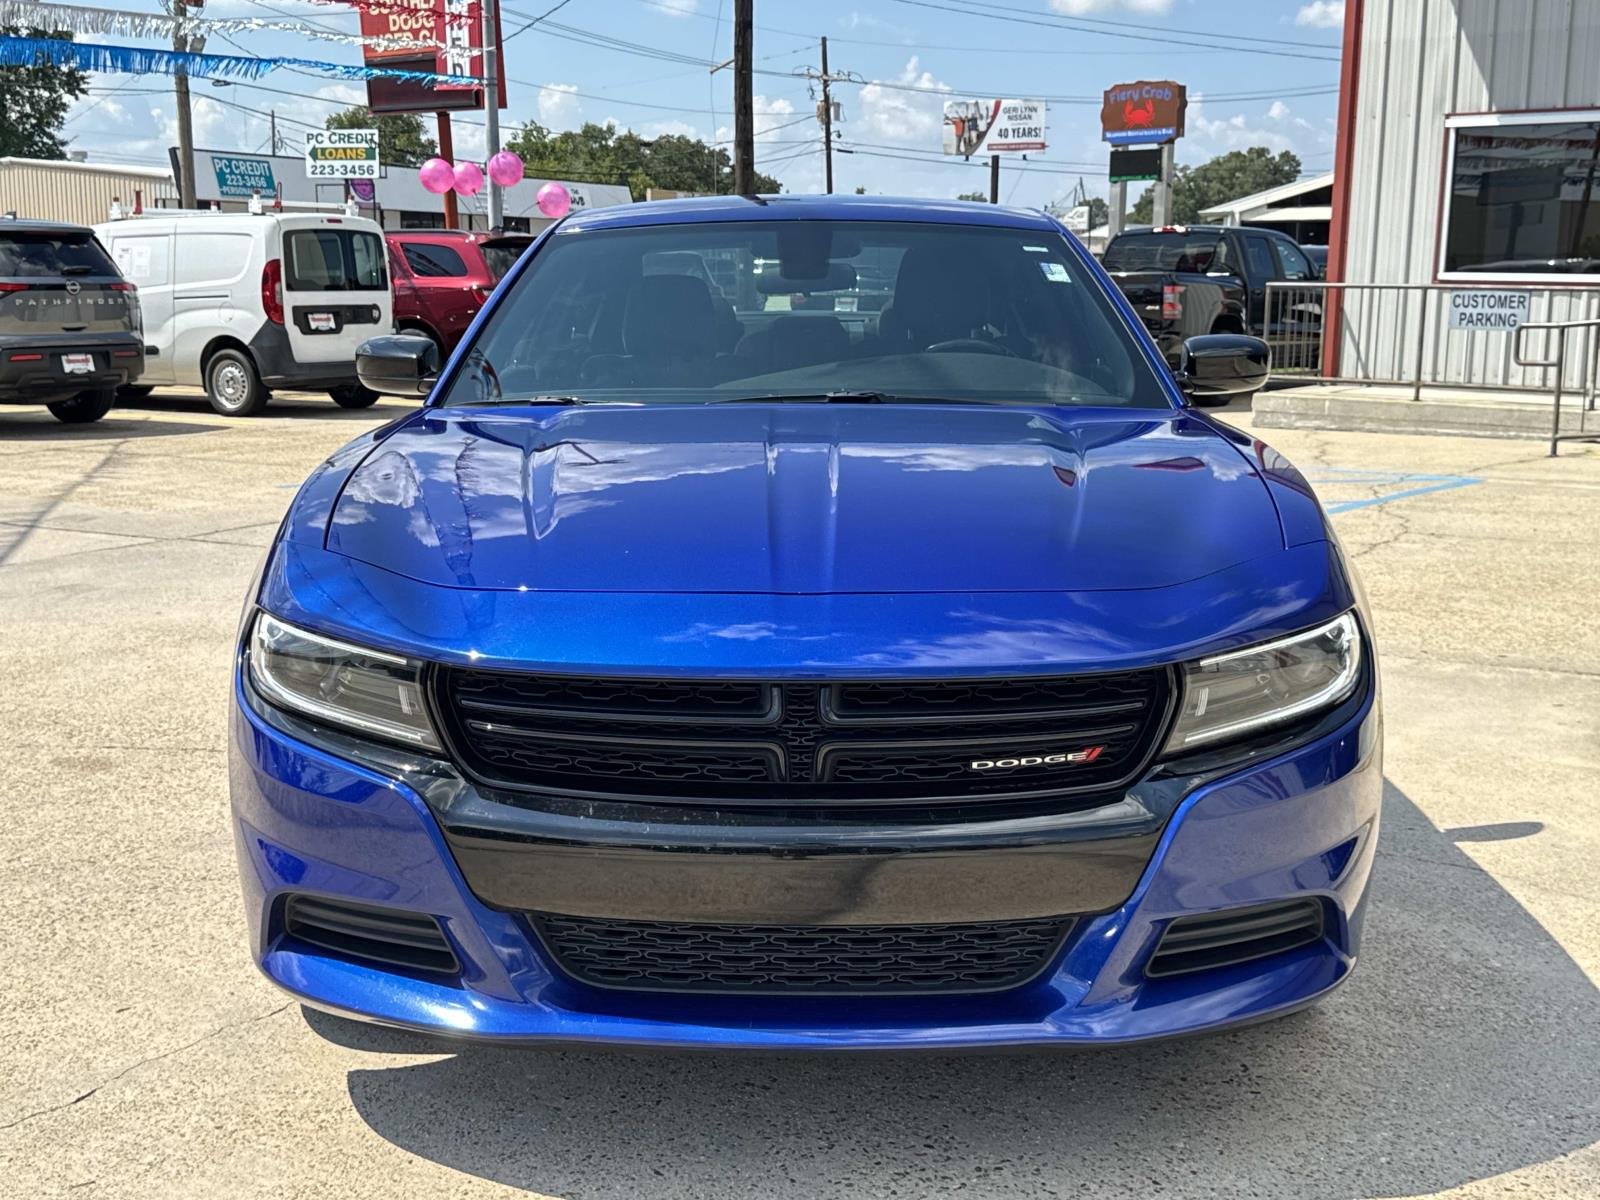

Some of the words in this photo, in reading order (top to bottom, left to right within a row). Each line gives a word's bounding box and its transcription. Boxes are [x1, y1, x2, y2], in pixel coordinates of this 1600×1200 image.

[1142, 86, 1171, 101] Crab
[306, 133, 325, 144] PC
[328, 133, 376, 144] CREDIT
[997, 128, 1009, 139] 40
[1011, 127, 1041, 138] YEARS!
[317, 148, 367, 160] LOANS
[213, 159, 230, 173] PC
[231, 160, 269, 176] CREDIT
[310, 164, 375, 176] 223-3456
[225, 174, 267, 188] 223-3456
[15, 298, 127, 306] PATHFINDER
[1452, 294, 1527, 310] CUSTOMER
[1458, 312, 1518, 328] PARKING
[971, 751, 1088, 770] DODGE
